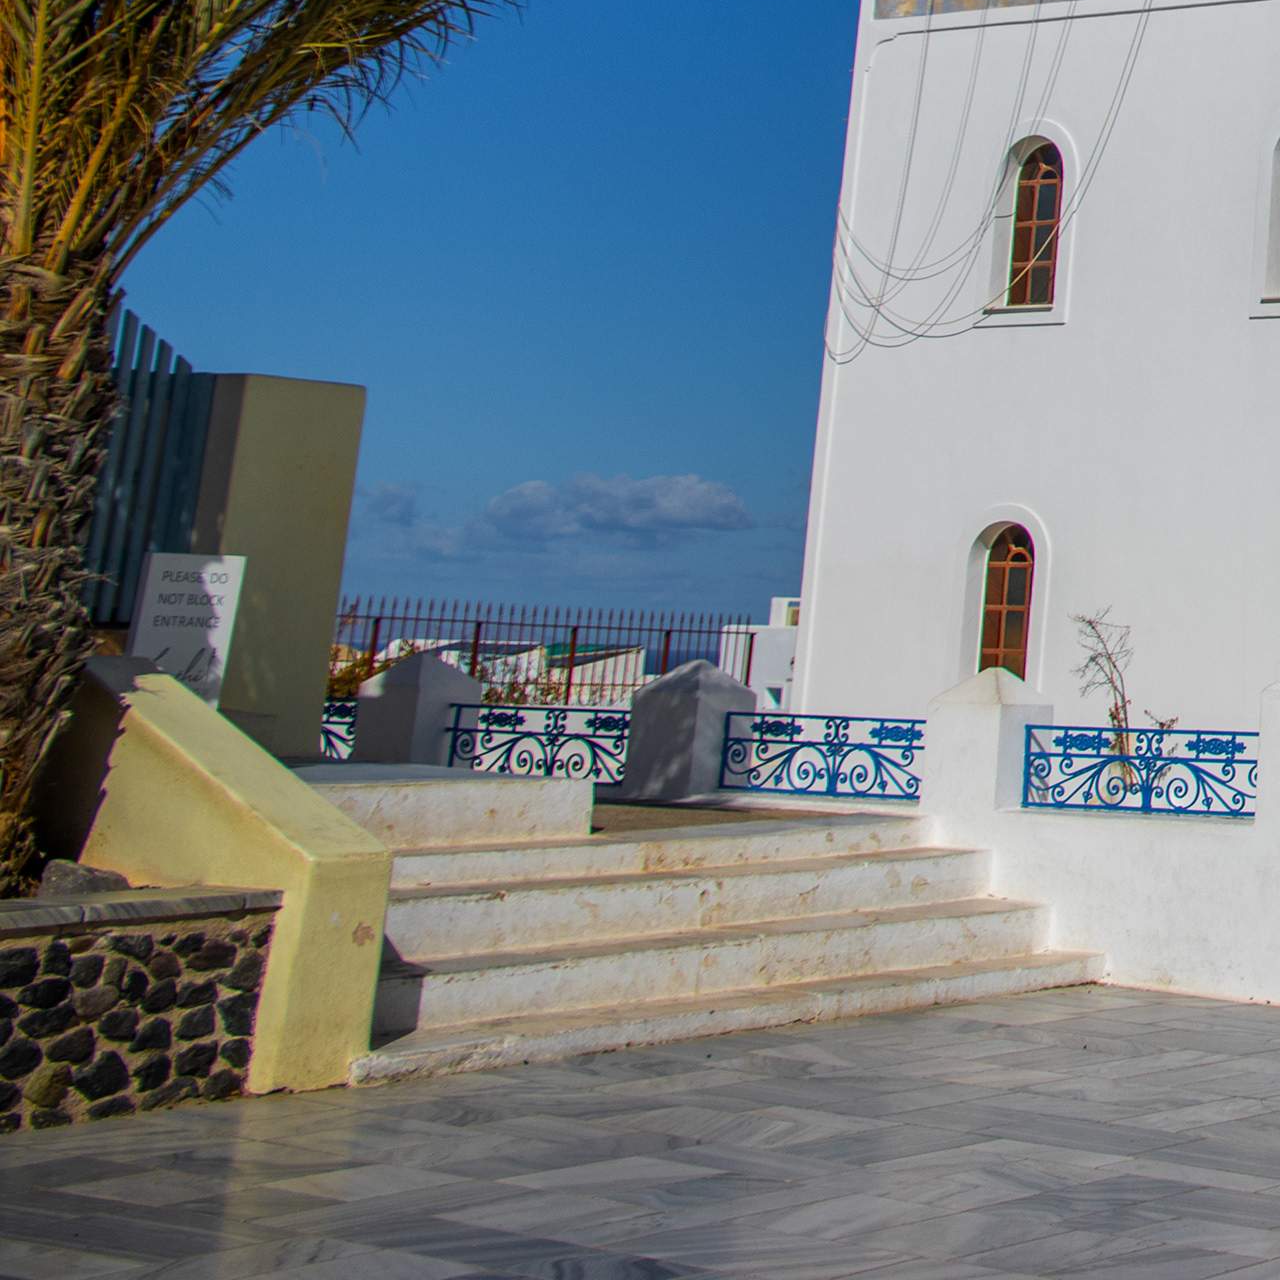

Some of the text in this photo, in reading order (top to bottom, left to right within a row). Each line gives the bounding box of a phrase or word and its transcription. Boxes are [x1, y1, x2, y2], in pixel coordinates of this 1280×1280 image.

[161, 570, 229, 585] PLEASE DO
[157, 593, 226, 607] NOT BLOCK
[153, 615, 221, 629] ENTRANCE
